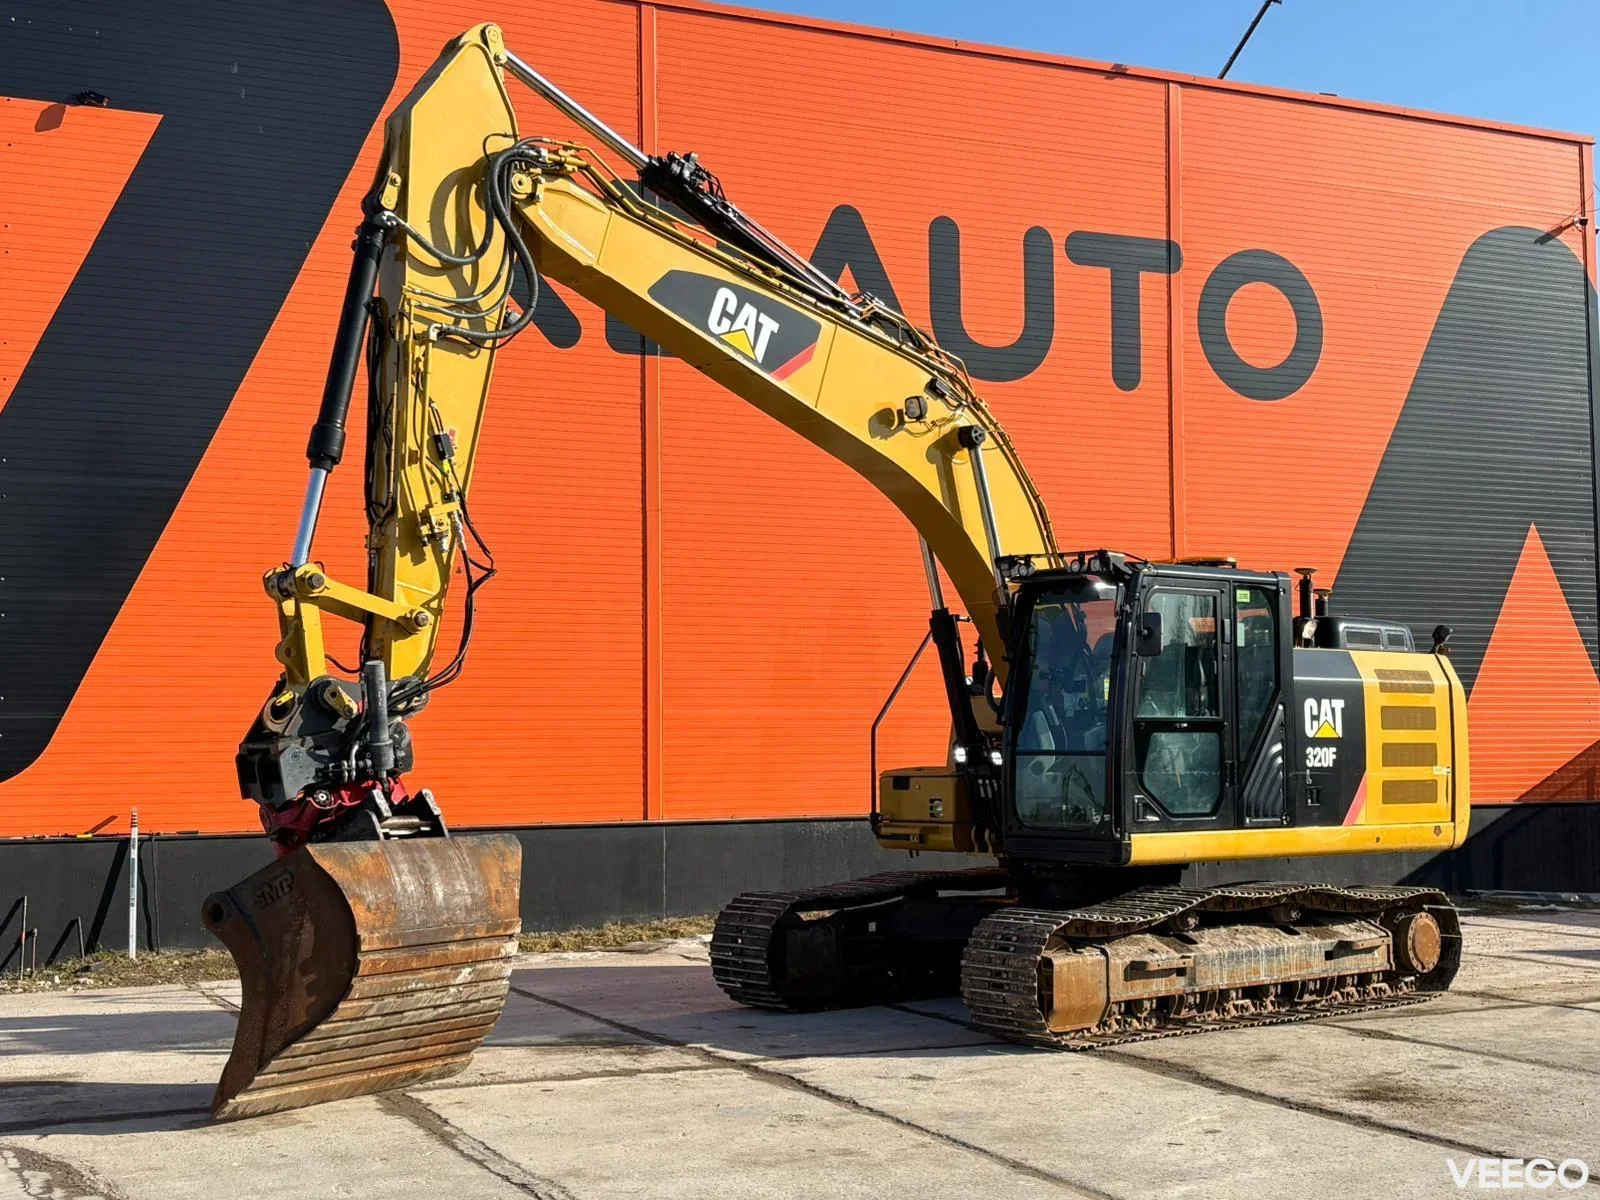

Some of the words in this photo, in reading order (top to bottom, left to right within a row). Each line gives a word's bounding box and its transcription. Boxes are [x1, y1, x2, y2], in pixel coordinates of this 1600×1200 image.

[707, 287, 780, 364] CAT
[808, 205, 1324, 401] AUTO
[1304, 698, 1345, 738] CAT
[1306, 747, 1337, 768] 320F
